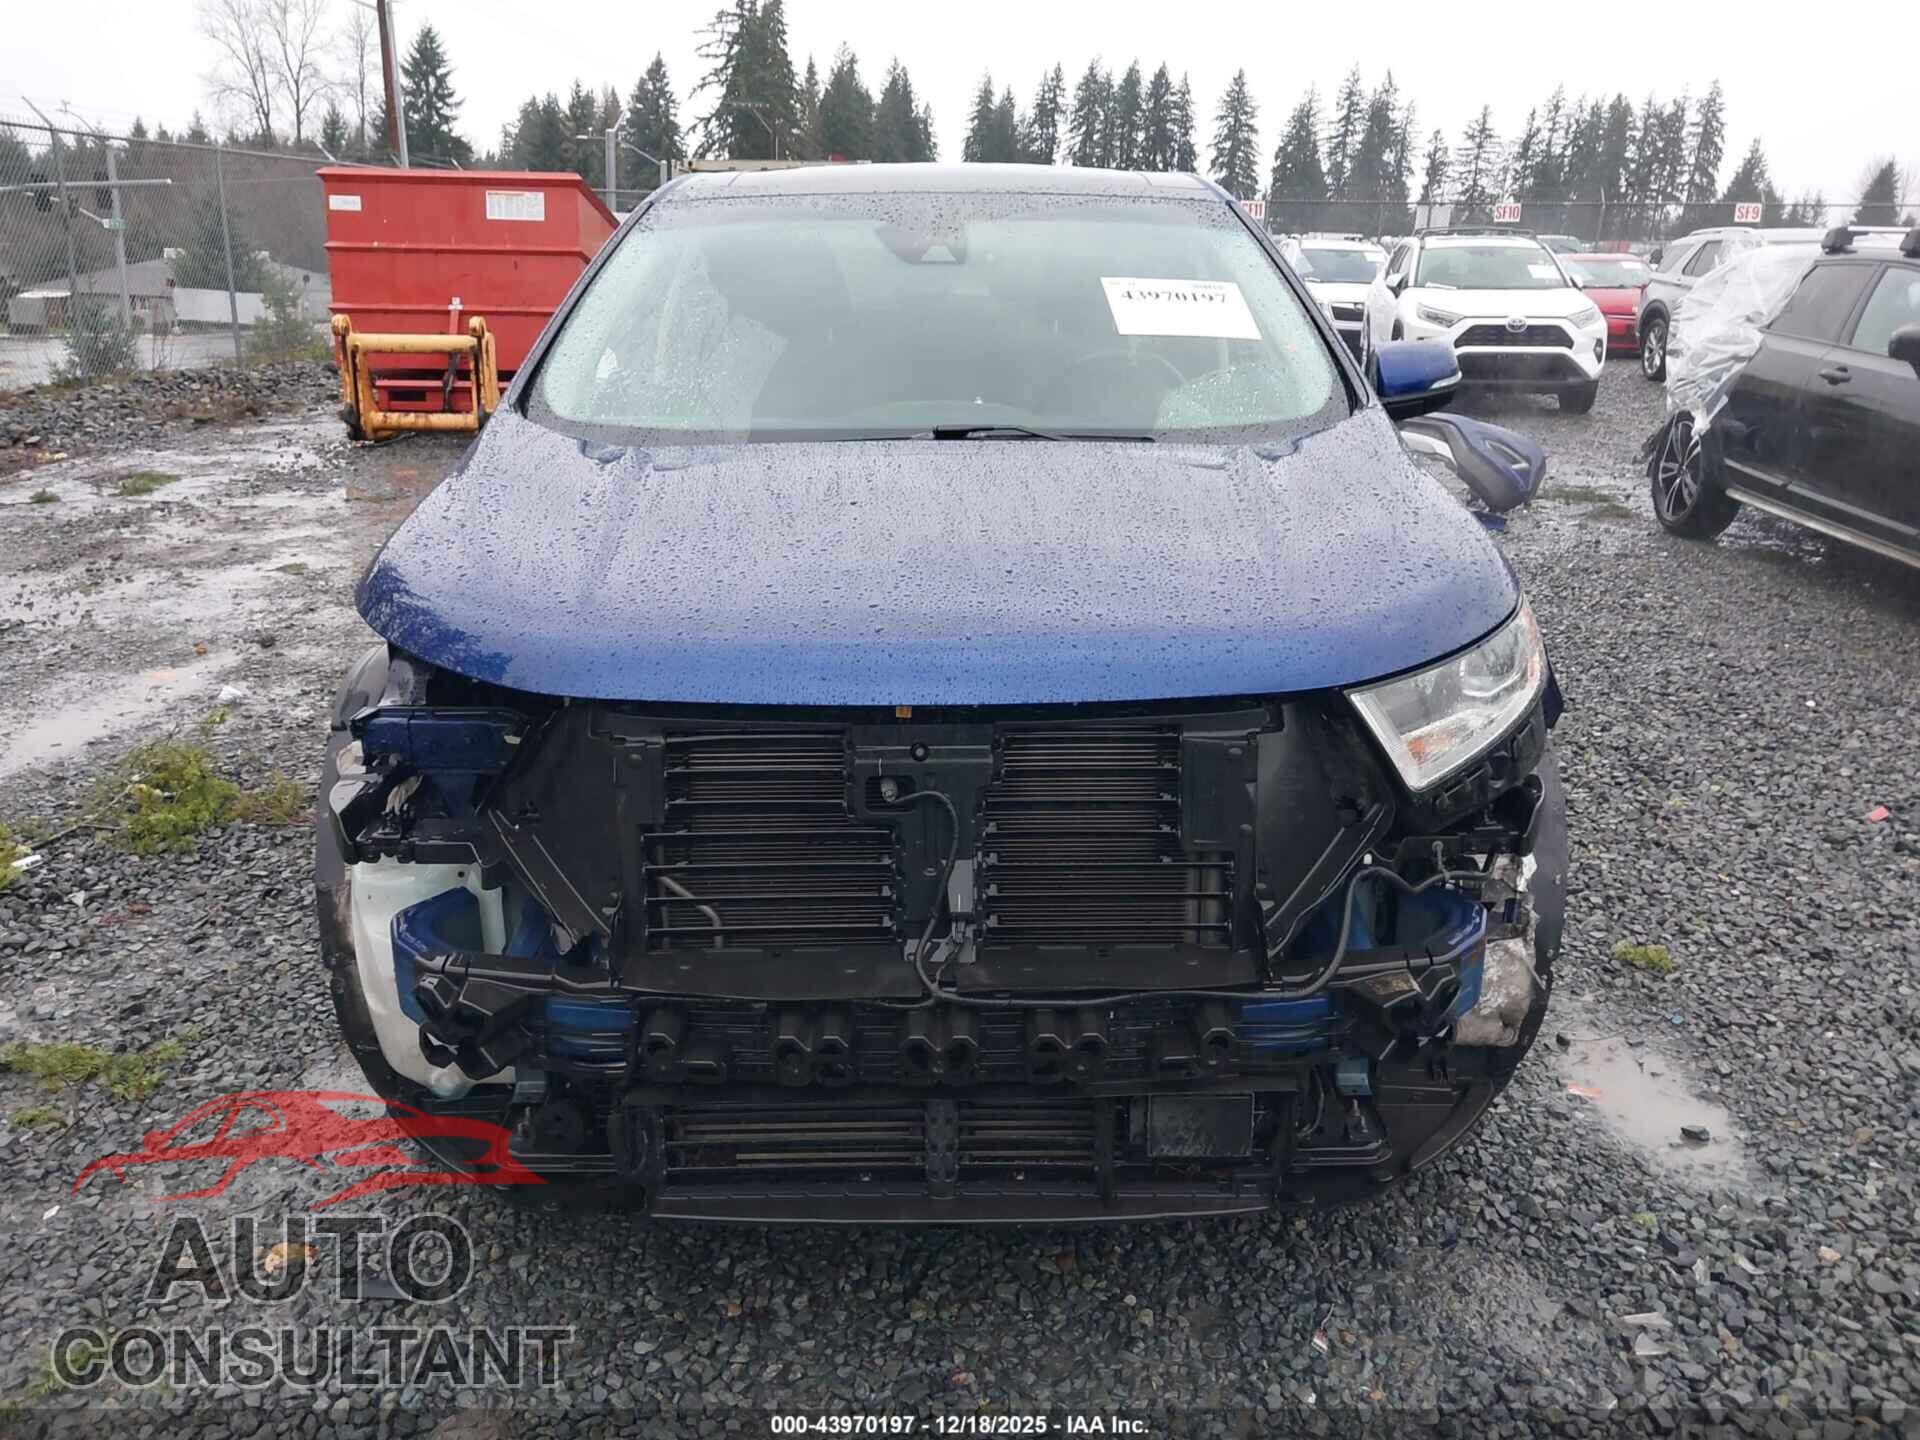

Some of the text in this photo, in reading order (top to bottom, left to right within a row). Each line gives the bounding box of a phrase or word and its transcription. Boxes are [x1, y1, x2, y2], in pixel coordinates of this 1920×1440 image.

[1496, 206, 1519, 219] SF10
[1737, 206, 1760, 220] SF9
[1120, 290, 1226, 303] 43970197
